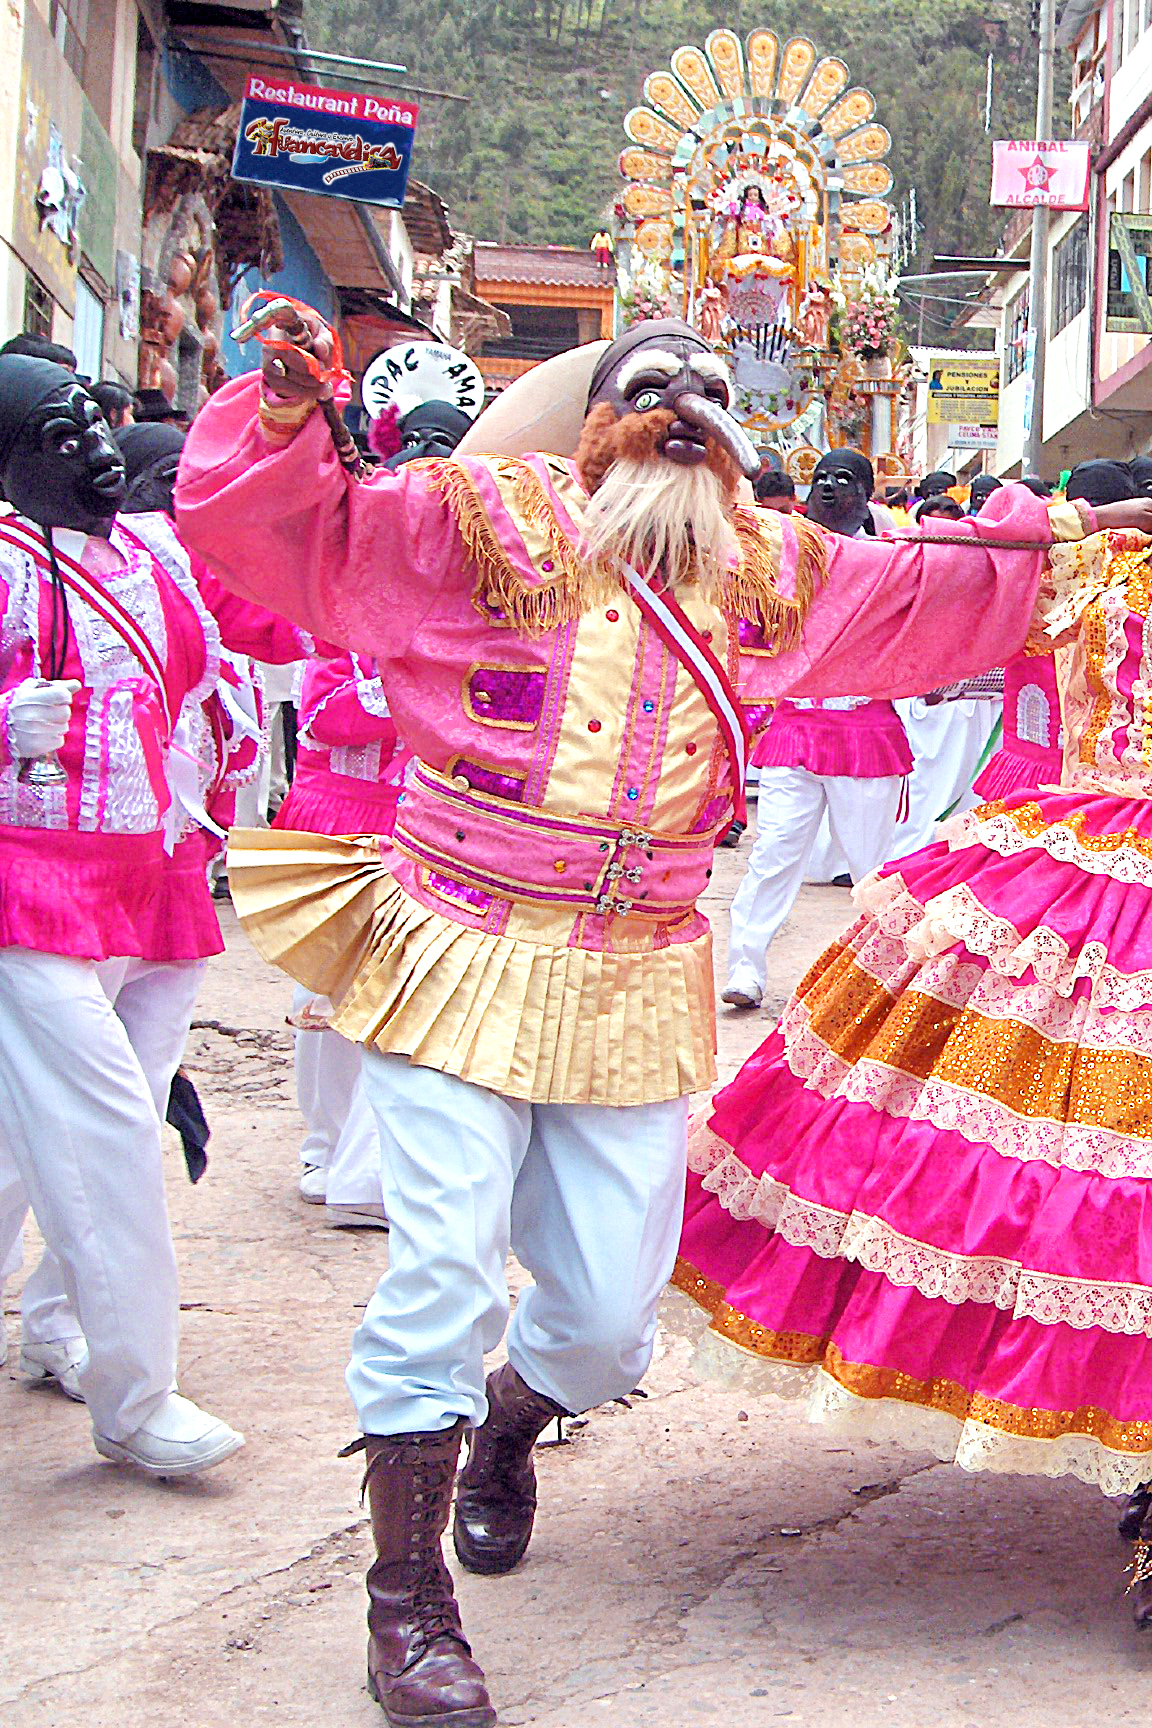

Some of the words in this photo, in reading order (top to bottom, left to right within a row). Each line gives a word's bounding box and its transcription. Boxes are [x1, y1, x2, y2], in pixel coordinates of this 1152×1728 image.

[250, 78, 358, 115] Restaurant
[364, 98, 413, 125] Peña
[1007, 140, 1069, 153] ANIBAL
[1006, 194, 1067, 205] ALCALDE
[442, 363, 476, 407] AMA
